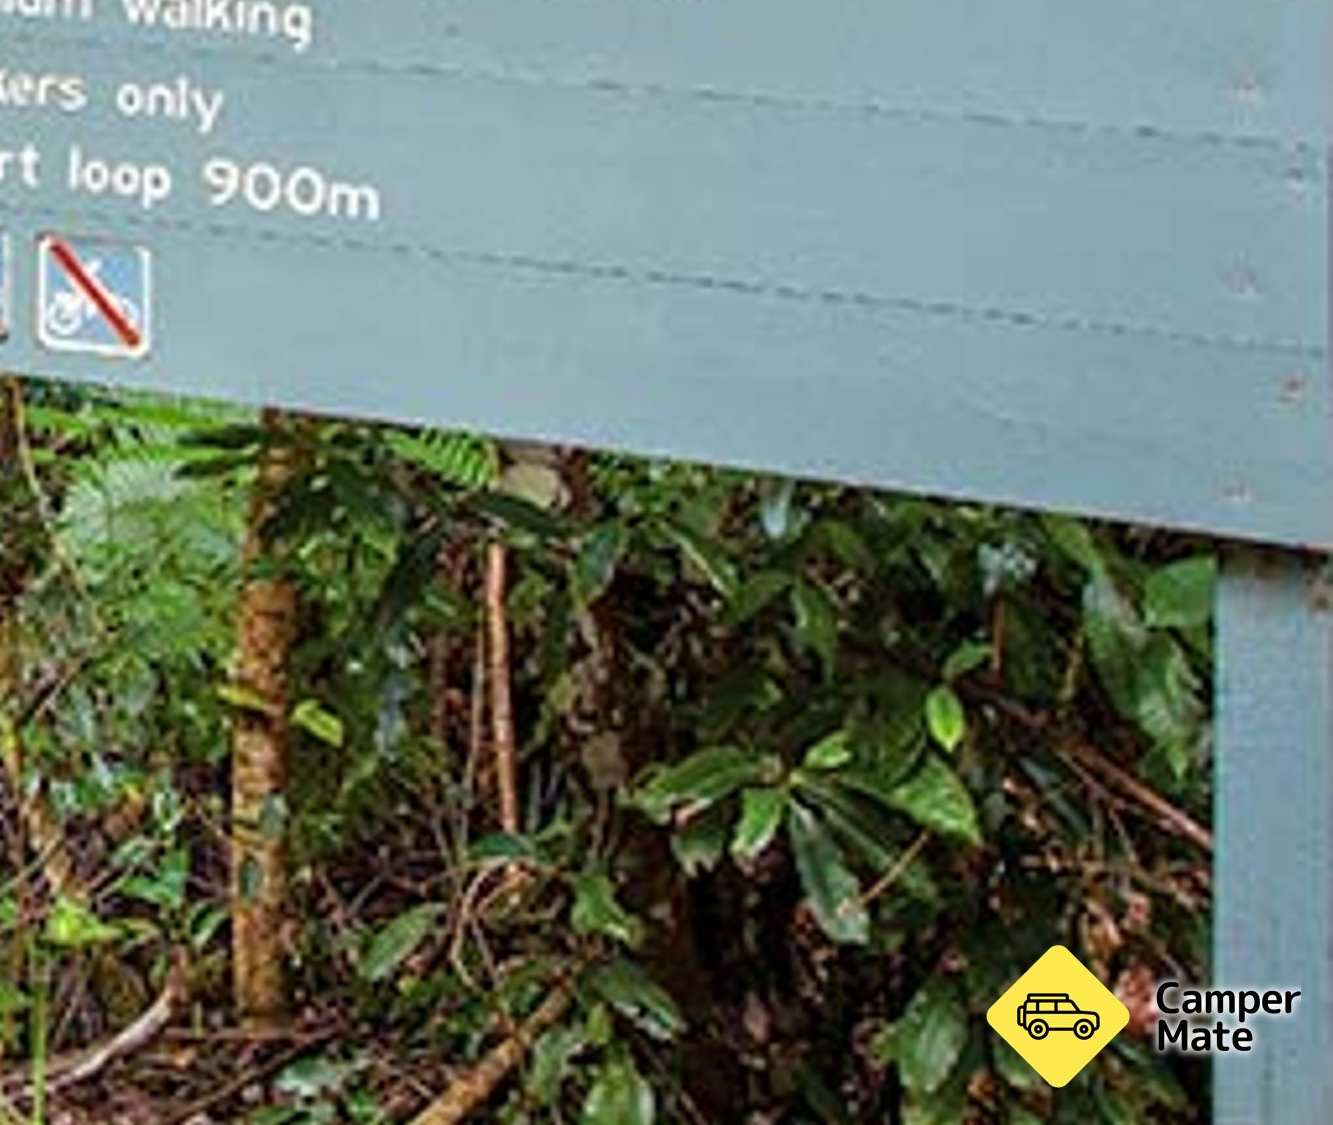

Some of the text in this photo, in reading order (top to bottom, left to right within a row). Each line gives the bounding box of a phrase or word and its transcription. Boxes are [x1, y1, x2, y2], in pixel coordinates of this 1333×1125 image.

[115, 75, 225, 135] only
[67, 146, 173, 211] loop
[201, 156, 381, 221] 900m
